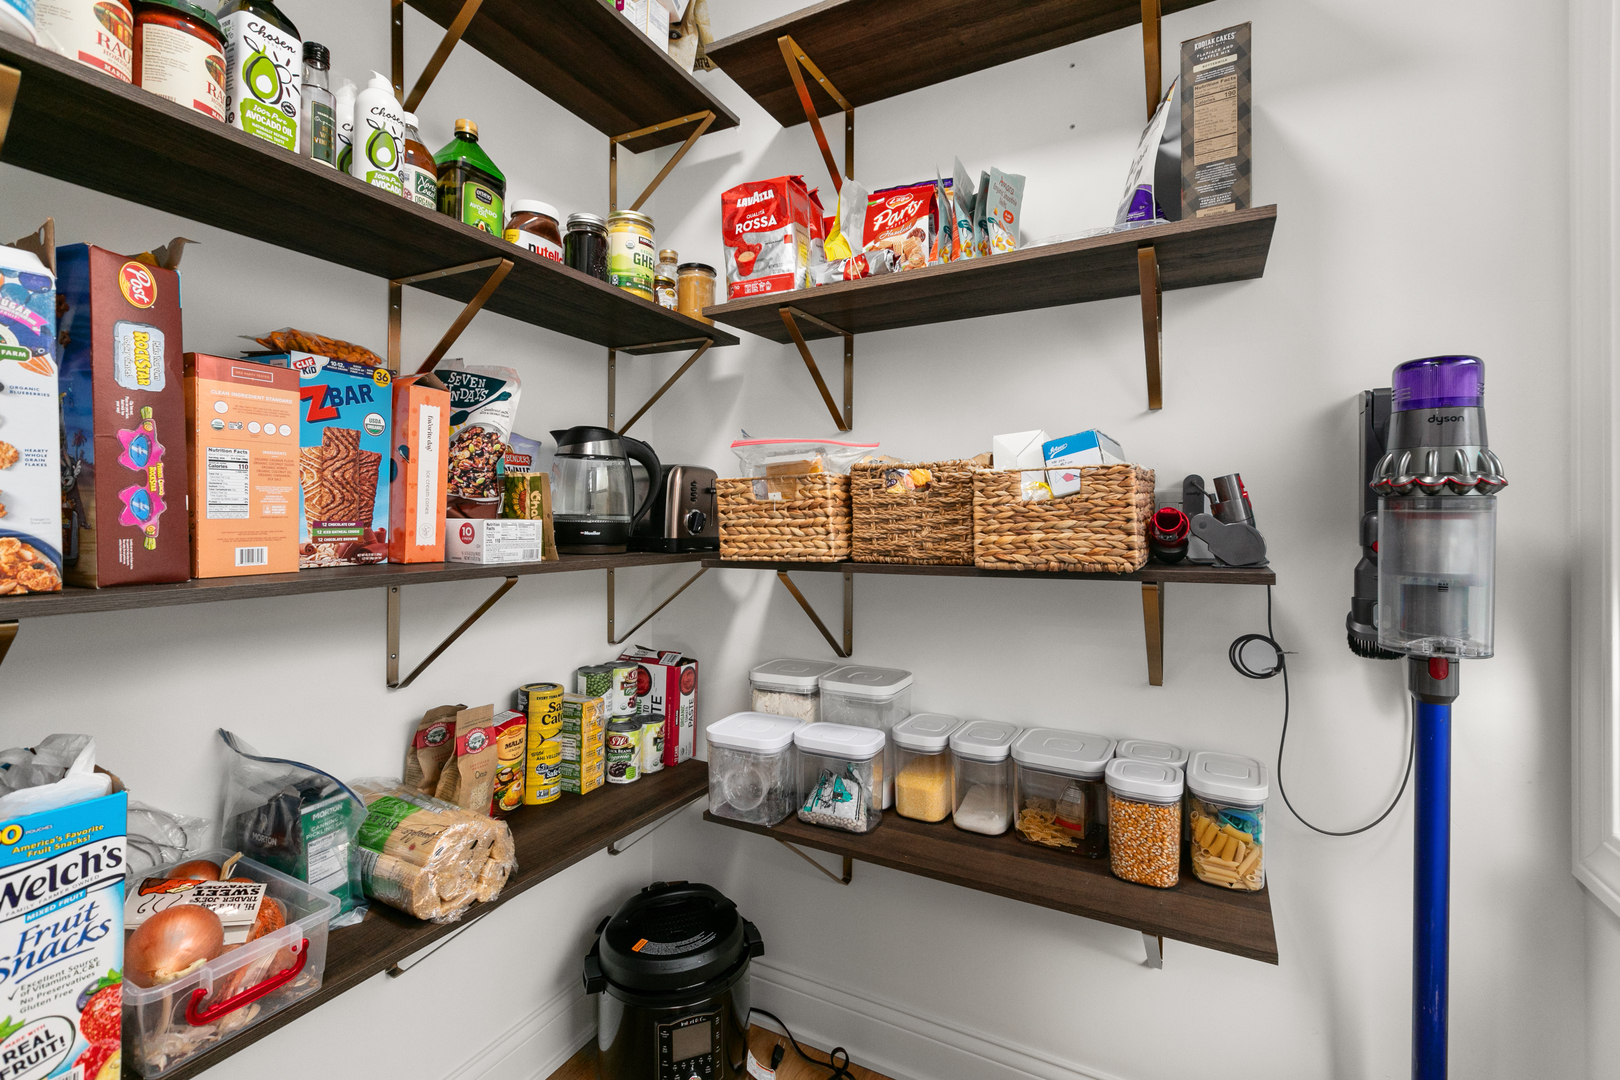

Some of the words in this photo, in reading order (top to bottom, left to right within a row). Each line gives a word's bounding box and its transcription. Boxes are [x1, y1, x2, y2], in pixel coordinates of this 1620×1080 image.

[247, 21, 297, 54] Chosen
[1194, 37, 1216, 51] KODIAK
[1215, 32, 1235, 43] CAKES
[252, 104, 271, 119] 100%
[245, 109, 282, 132] AVOCADO
[282, 125, 293, 138] OIL
[469, 201, 498, 219] AVOCADO
[736, 189, 775, 208] LAVAZZA
[873, 199, 926, 231] Party
[130, 264, 150, 305] Post
[0, 299, 32, 317] UGAR
[1, 348, 27, 358] FARM
[295, 357, 316, 369] CLIF
[9, 384, 41, 392] ORGANIC
[375, 371, 389, 383] 36
[448, 372, 486, 388] SEVEN
[9, 389, 51, 397] BLUEBERRIES
[230, 391, 264, 401] INGREDIENT
[265, 396, 293, 404] STANDARD
[426, 415, 434, 439] favorite
[1427, 413, 1466, 426] dyson
[461, 526, 473, 537] 10
[312, 802, 344, 821] MORTON
[0, 823, 25, 846] 0
[11, 834, 63, 855] America's
[65, 823, 105, 840] Favorite
[25, 824, 54, 835] POUCHES
[26, 845, 52, 859] Fruit
[53, 834, 92, 852] Snacks!
[0, 844, 124, 909] Welch's
[5, 902, 35, 918] FAMILY
[38, 887, 70, 906] FARMER
[71, 873, 101, 890] OWNED
[190, 896, 220, 904] JOE'S
[192, 888, 260, 897] SWEET
[26, 904, 58, 921] MIXED
[57, 890, 86, 909] FRUIT
[15, 900, 101, 957] Fruit
[0, 918, 112, 985] Snacks
[19, 969, 66, 991] Excellent
[67, 956, 99, 974] Source
[19, 996, 34, 1006] No
[36, 971, 96, 1000] Preservatives
[20, 987, 30, 998] of
[30, 974, 72, 994] Vitamins
[19, 998, 51, 1014] Gluten
[54, 988, 74, 1000] Free
[2, 1029, 56, 1065] REAL
[4, 1035, 25, 1049] MADE
[26, 1023, 46, 1036] WITH
[0, 1035, 66, 1080] FRUIT!
